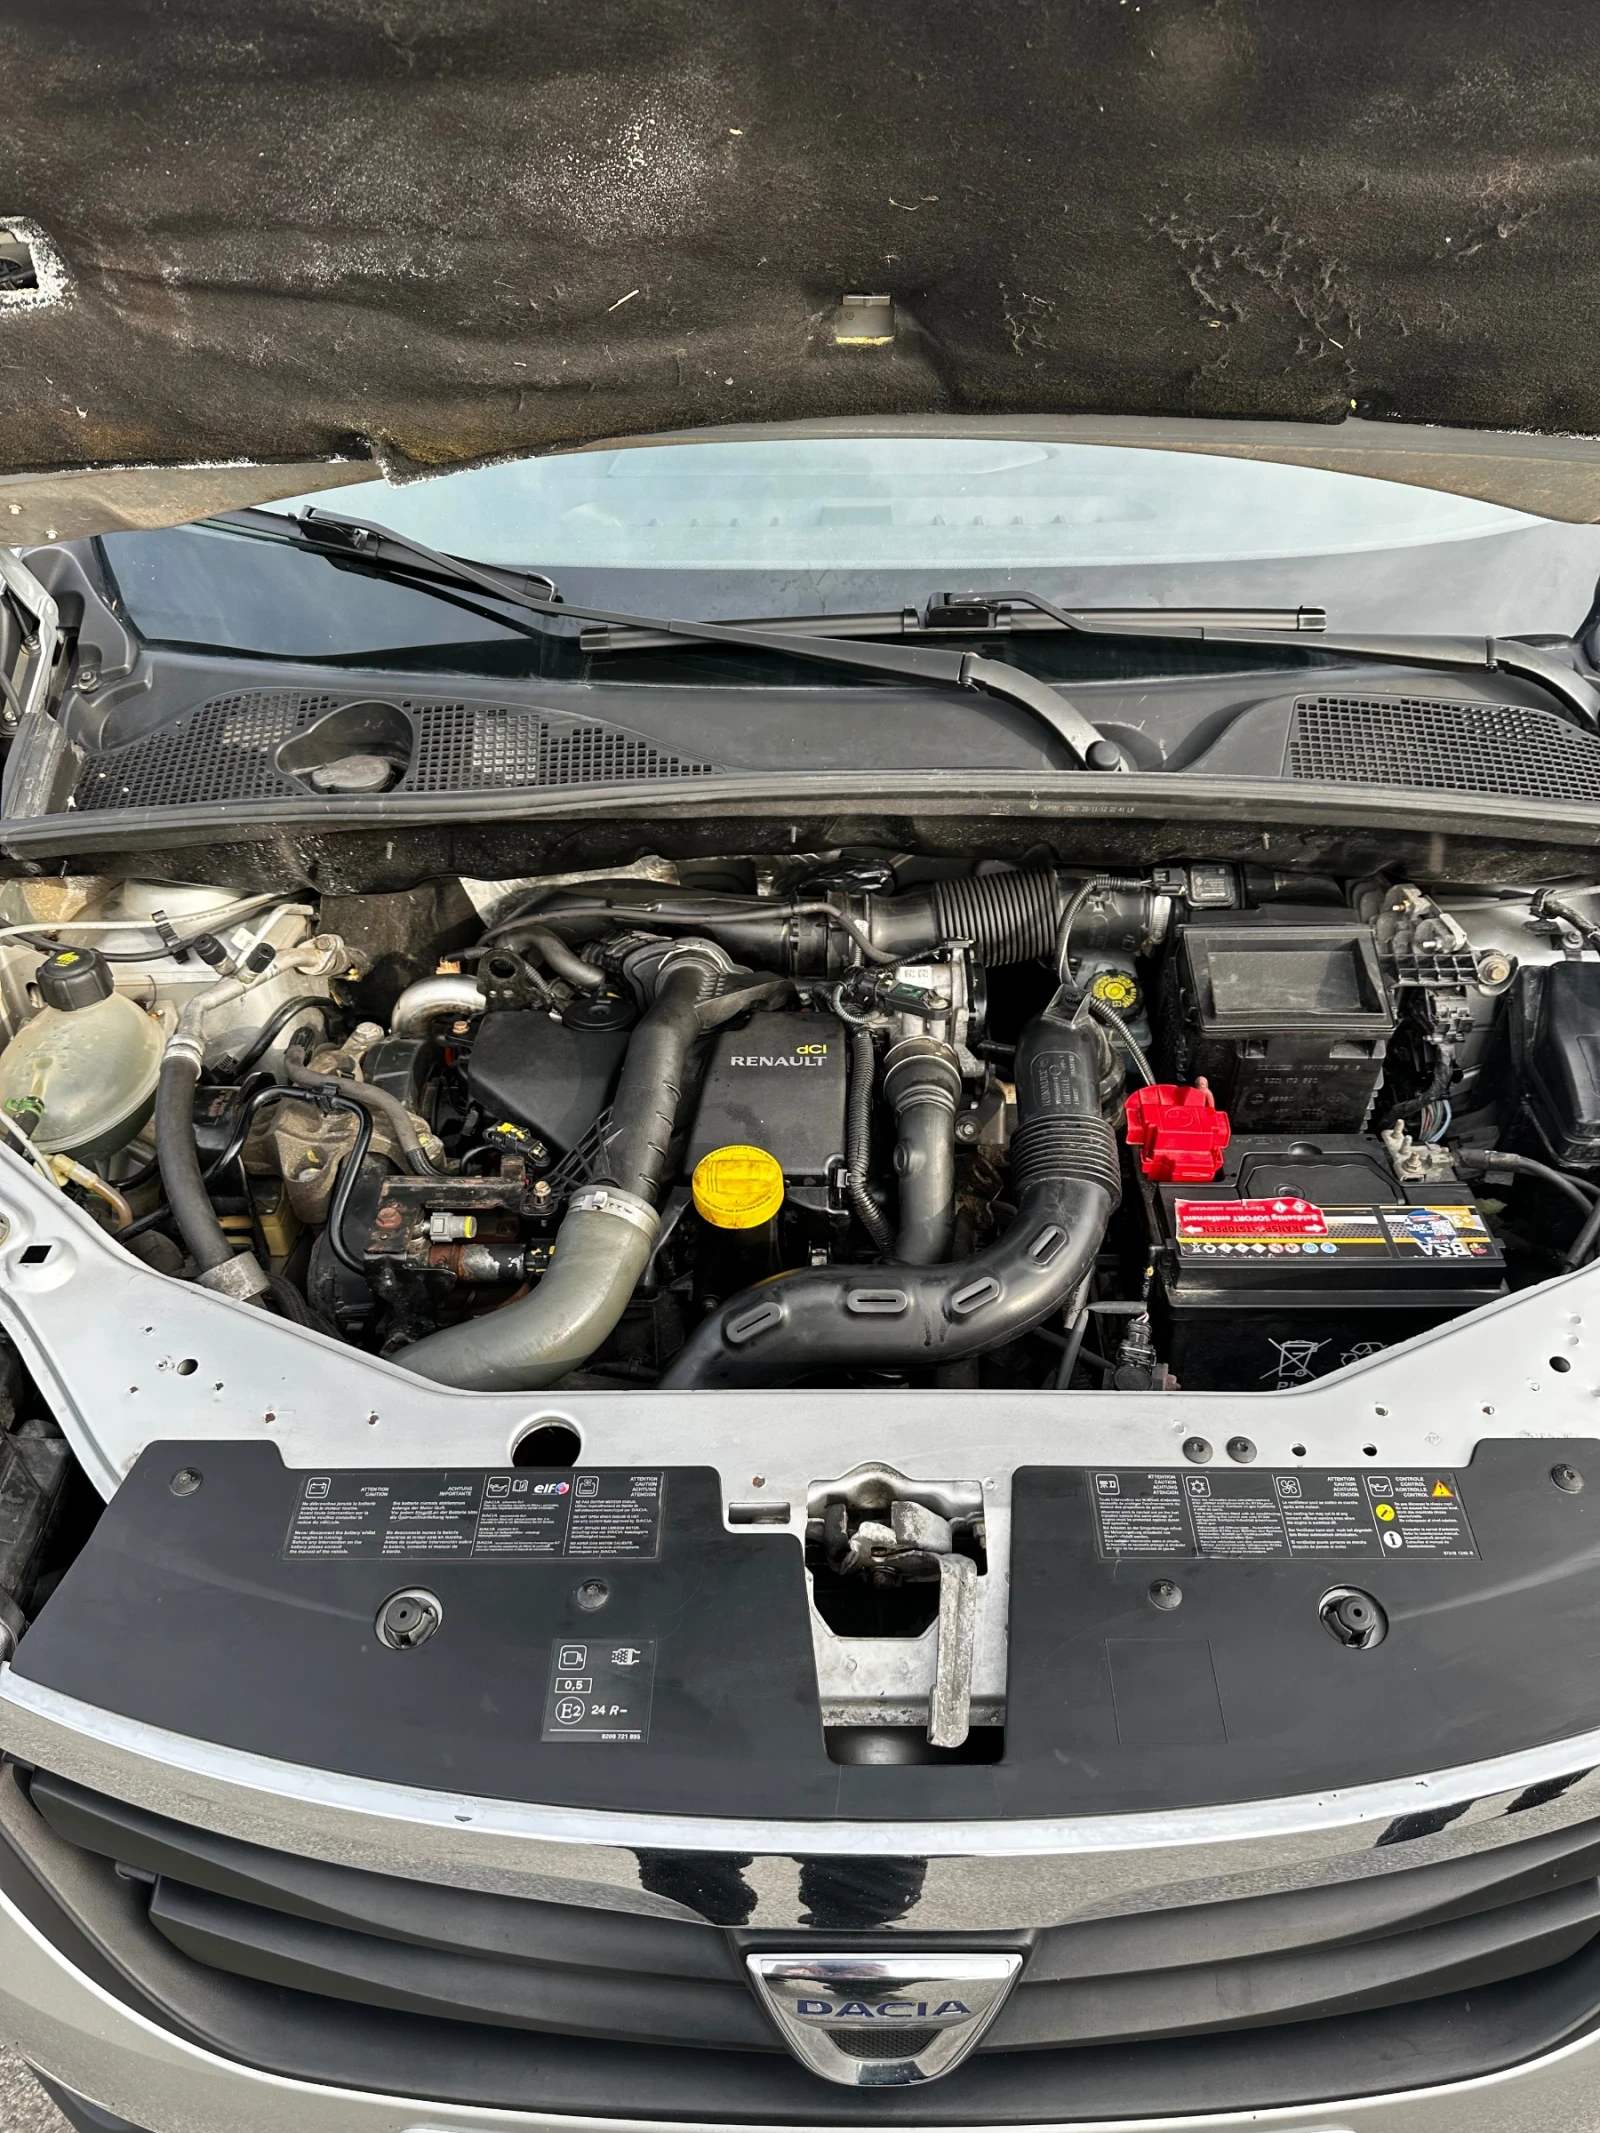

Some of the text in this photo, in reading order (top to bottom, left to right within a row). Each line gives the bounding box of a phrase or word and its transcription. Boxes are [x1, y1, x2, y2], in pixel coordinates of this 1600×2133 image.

[730, 1056, 827, 1067] RENAULT
[1418, 1242, 1472, 1256] BSA
[533, 1483, 557, 1494] elf
[565, 1680, 583, 1691] 0,5
[560, 1703, 581, 1719] E2
[591, 1705, 606, 1715] 24
[796, 1998, 971, 2018] DACIA
